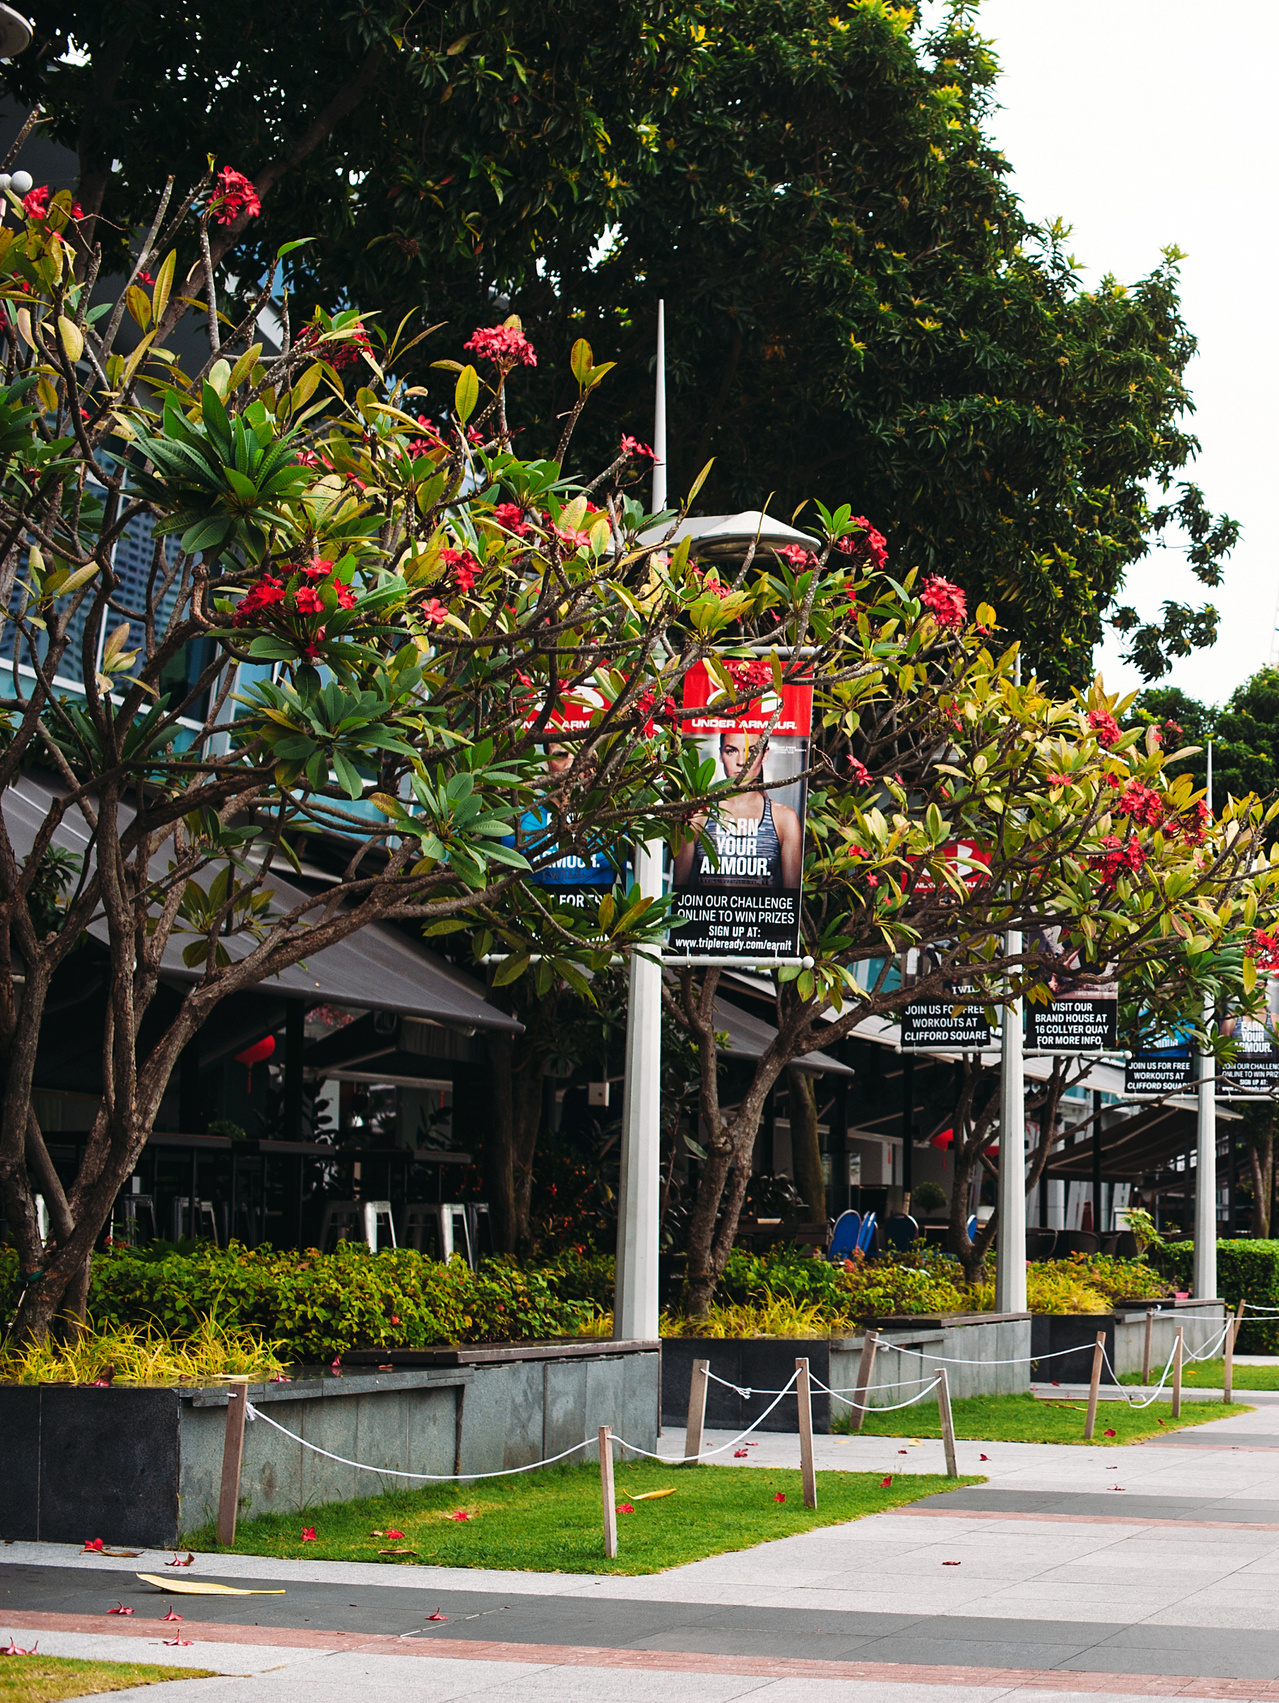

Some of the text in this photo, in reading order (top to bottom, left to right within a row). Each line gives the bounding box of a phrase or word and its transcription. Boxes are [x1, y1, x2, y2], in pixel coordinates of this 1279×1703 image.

[691, 719, 735, 728] UNDER
[716, 818, 758, 836] EARN
[716, 837, 757, 855] YOUR
[678, 894, 793, 910] JOIN OUR CHALLENGE
[677, 909, 795, 924] ONLINE TO WIN PRIZES
[708, 925, 761, 938] SIGN UP AT:
[675, 938, 792, 951] www.tripleready.com/earnit
[905, 1005, 927, 1015] JOIN
[929, 1005, 941, 1014] US
[1051, 1003, 1092, 1011] VISIT OUR
[1035, 1014, 1107, 1022] BRAND HOUSE AT
[912, 1018, 978, 1028] WORKOUTS AT
[1035, 1025, 1109, 1034] 16 COLLYER QUAY
[904, 1031, 987, 1040] CLIFFORD SQUARE
[1242, 1032, 1264, 1041] YOUR
[1037, 1036, 1053, 1045] FOR
[1055, 1036, 1080, 1045] MORE
[1134, 1072, 1184, 1080] WORKOUTS AT
[1163, 1082, 1191, 1090] SQUA
